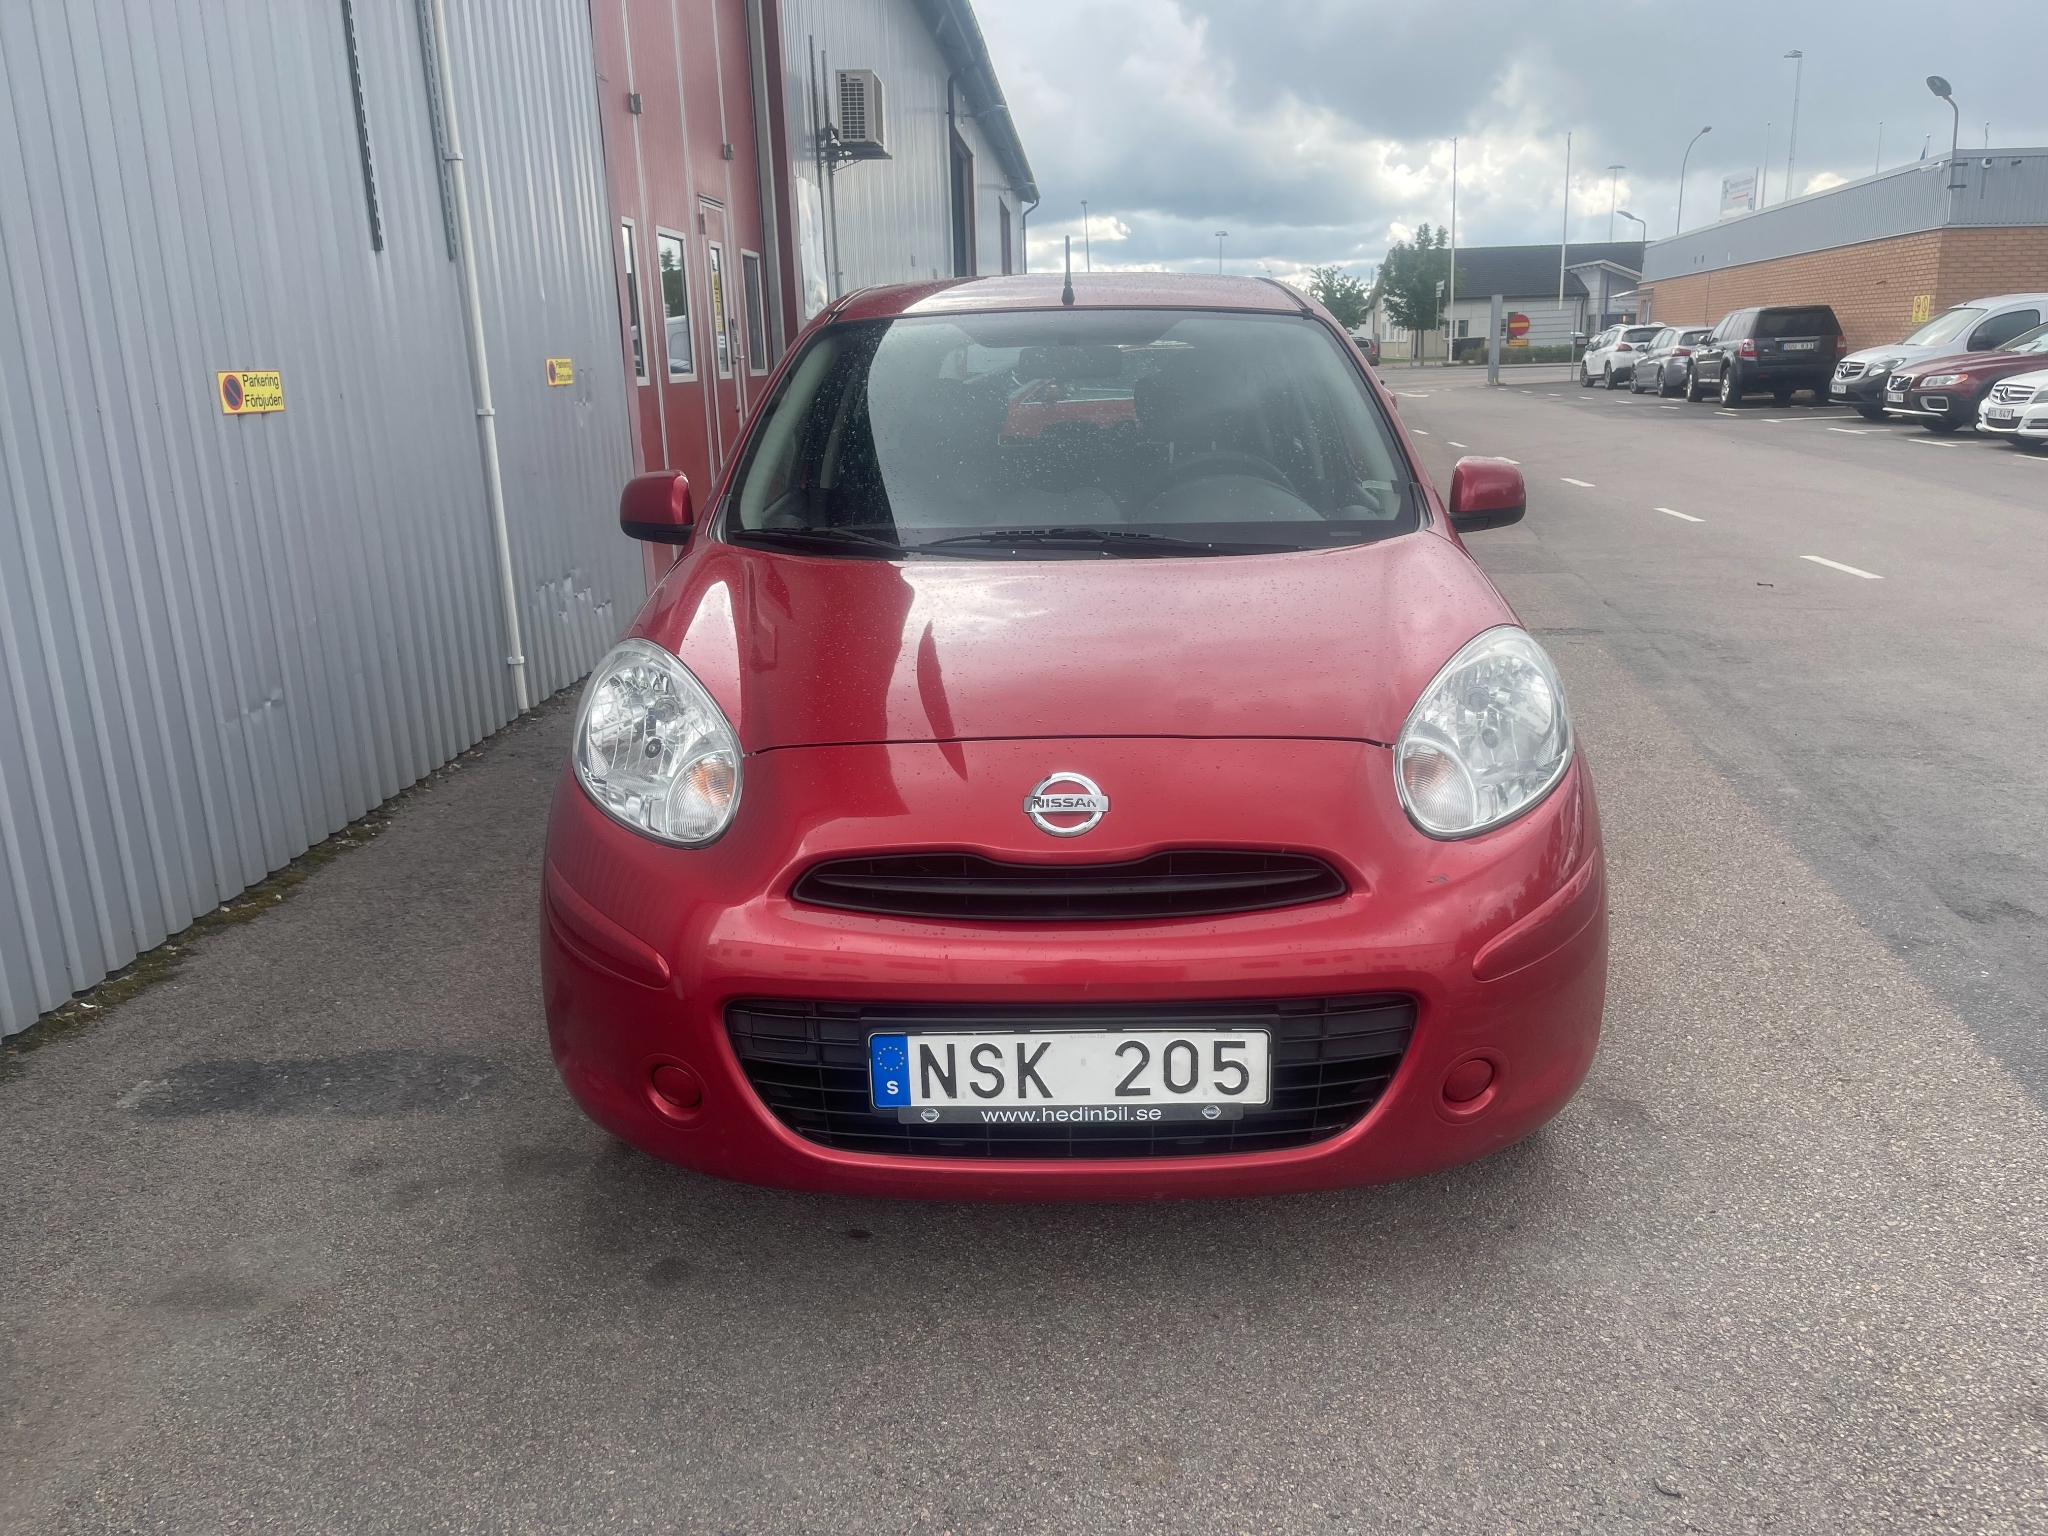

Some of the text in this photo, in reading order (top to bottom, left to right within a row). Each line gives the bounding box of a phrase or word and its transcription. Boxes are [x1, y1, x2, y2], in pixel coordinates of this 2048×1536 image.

[242, 374, 279, 389] Parkering
[245, 393, 283, 410] Förbjuden
[1032, 797, 1099, 809] NISSAN
[918, 1039, 1250, 1099] NSK 205
[886, 1080, 899, 1095] S
[980, 1106, 1162, 1123] www.hedinbil.se
